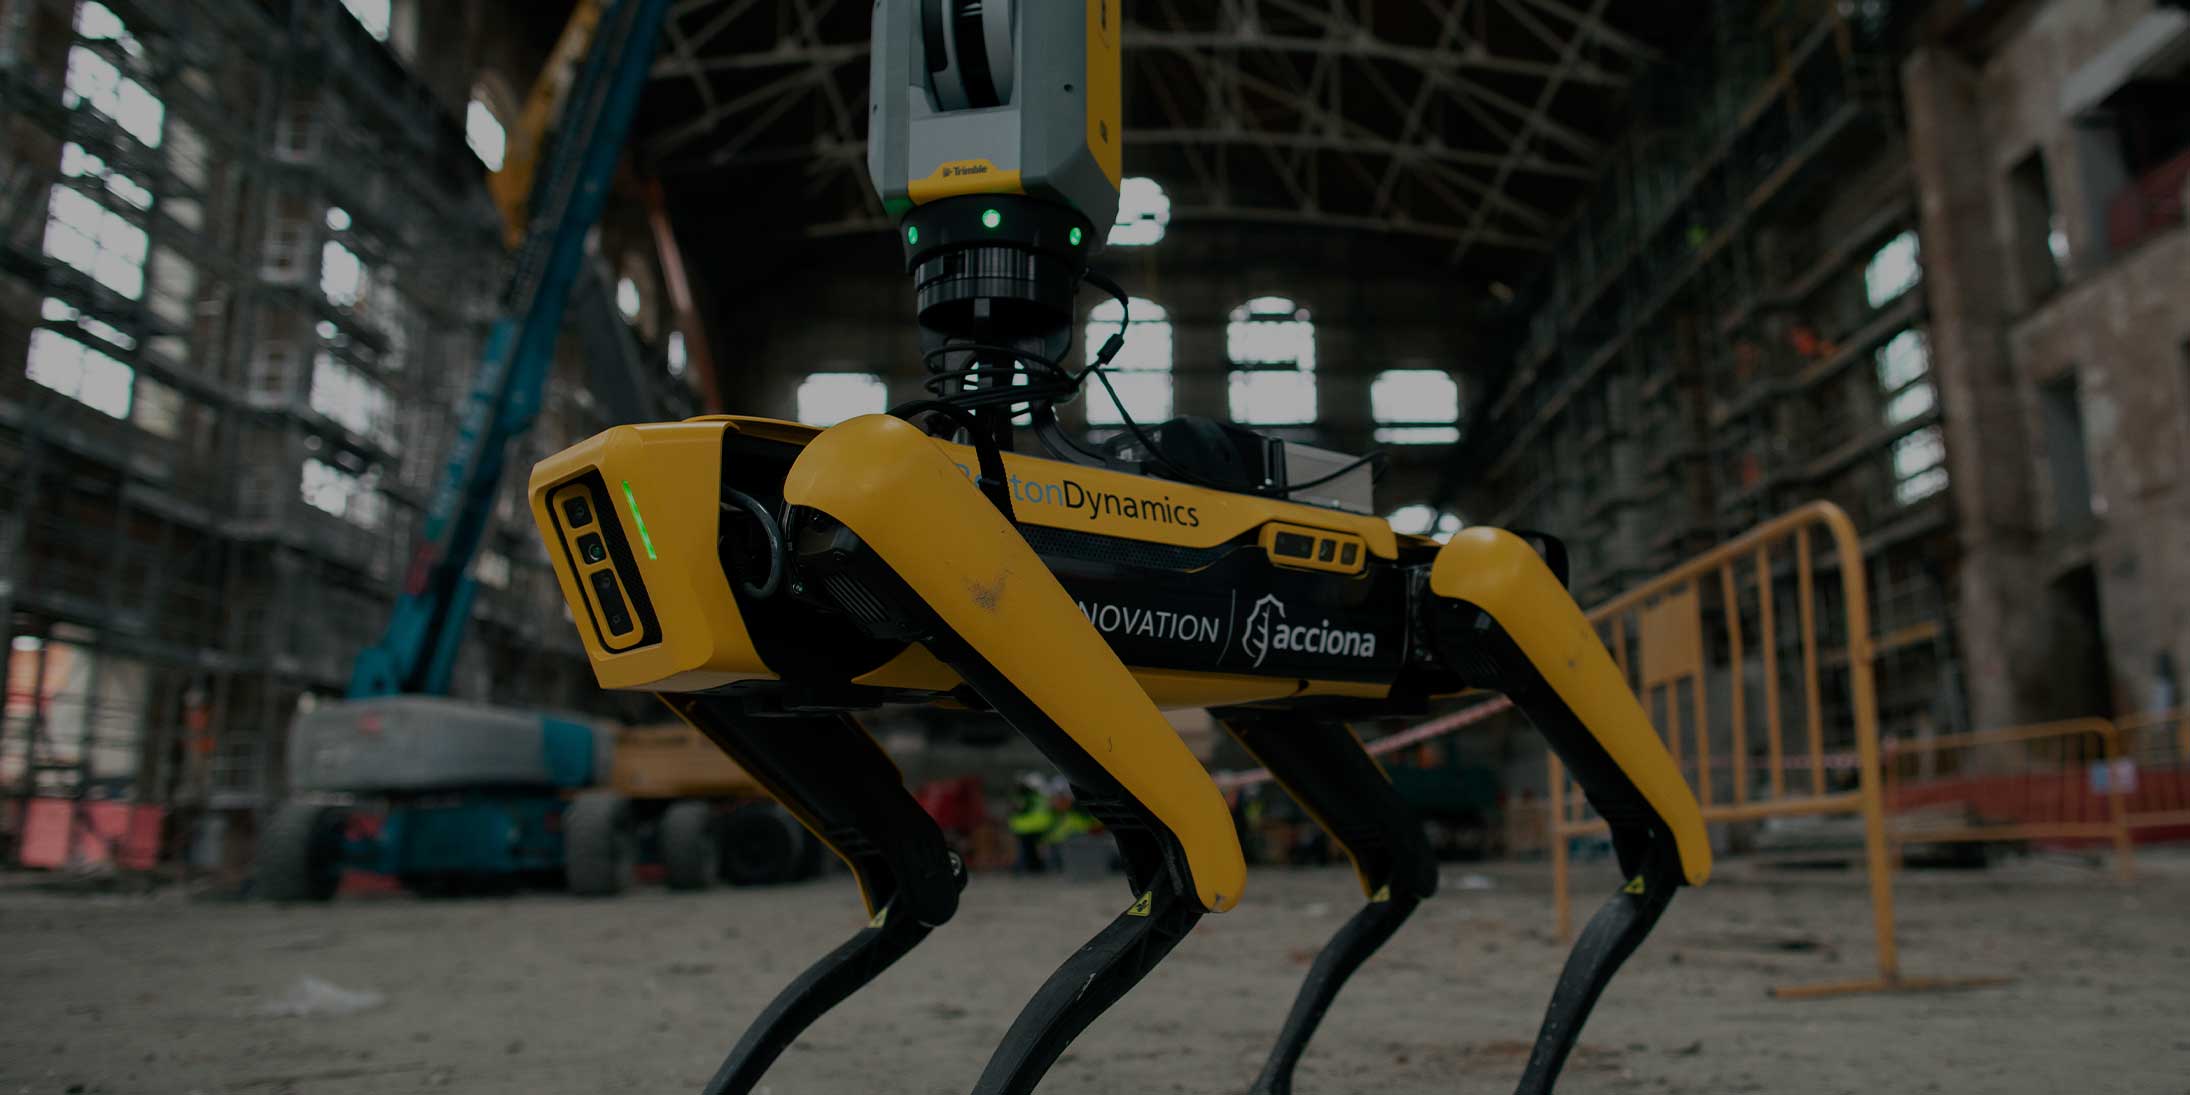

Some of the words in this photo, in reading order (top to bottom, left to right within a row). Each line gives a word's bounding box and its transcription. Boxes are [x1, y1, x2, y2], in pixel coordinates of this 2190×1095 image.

[956, 463, 1199, 527] tonDynamics
[1079, 600, 1219, 643] NOVATION
[1272, 618, 1376, 658] acciona
